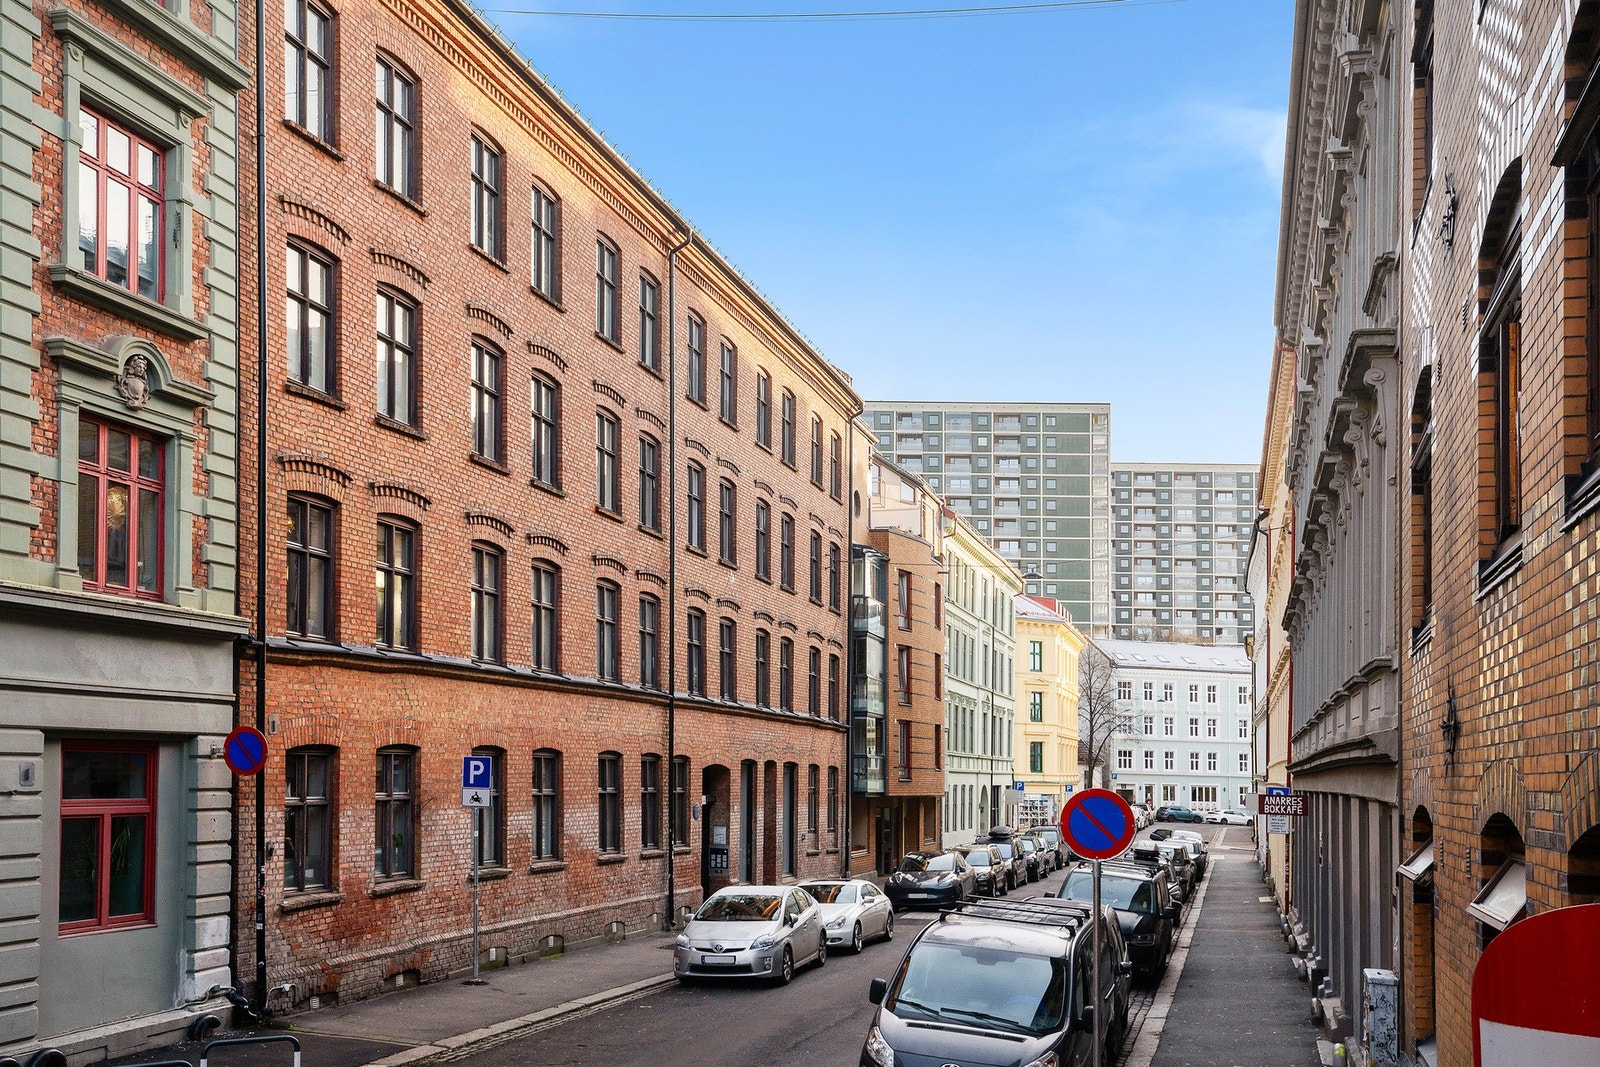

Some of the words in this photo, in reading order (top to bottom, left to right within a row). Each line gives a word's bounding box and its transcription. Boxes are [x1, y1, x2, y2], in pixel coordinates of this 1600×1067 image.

[469, 760, 485, 785] P
[1016, 782, 1023, 790] P
[1264, 796, 1303, 806] ANARRES
